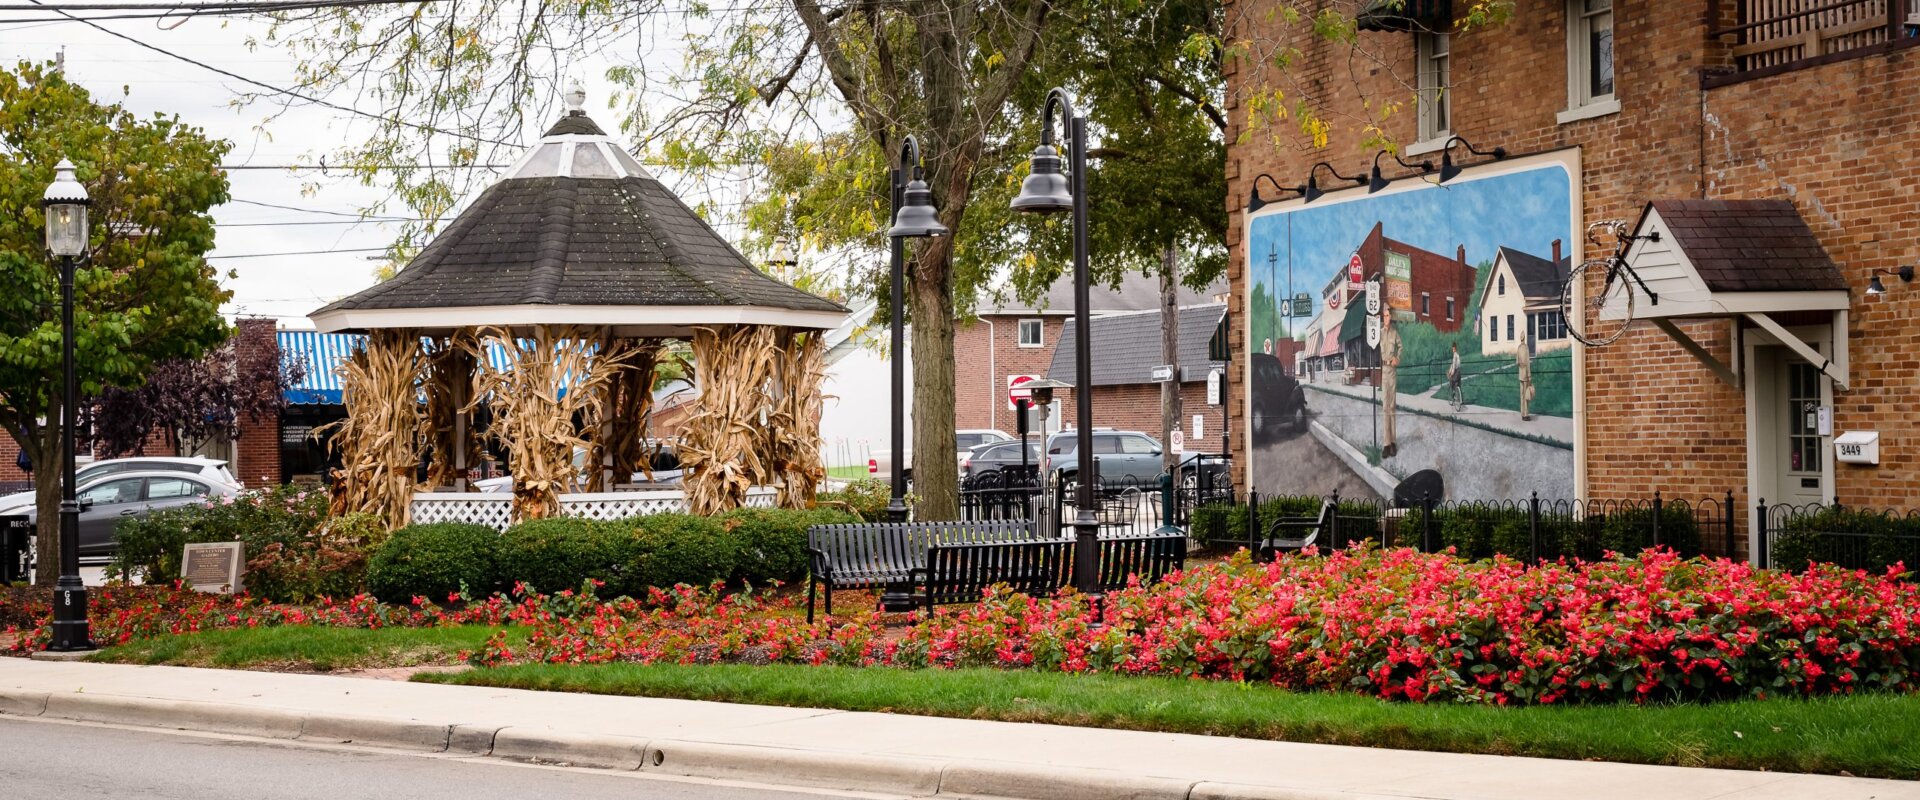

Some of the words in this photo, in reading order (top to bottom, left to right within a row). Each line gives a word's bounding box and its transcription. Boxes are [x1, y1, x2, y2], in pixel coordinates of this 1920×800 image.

[1369, 300, 1378, 311] 62
[1371, 328, 1376, 340] 3
[1841, 445, 1861, 456] 3449
[468, 470, 502, 478] SHES
